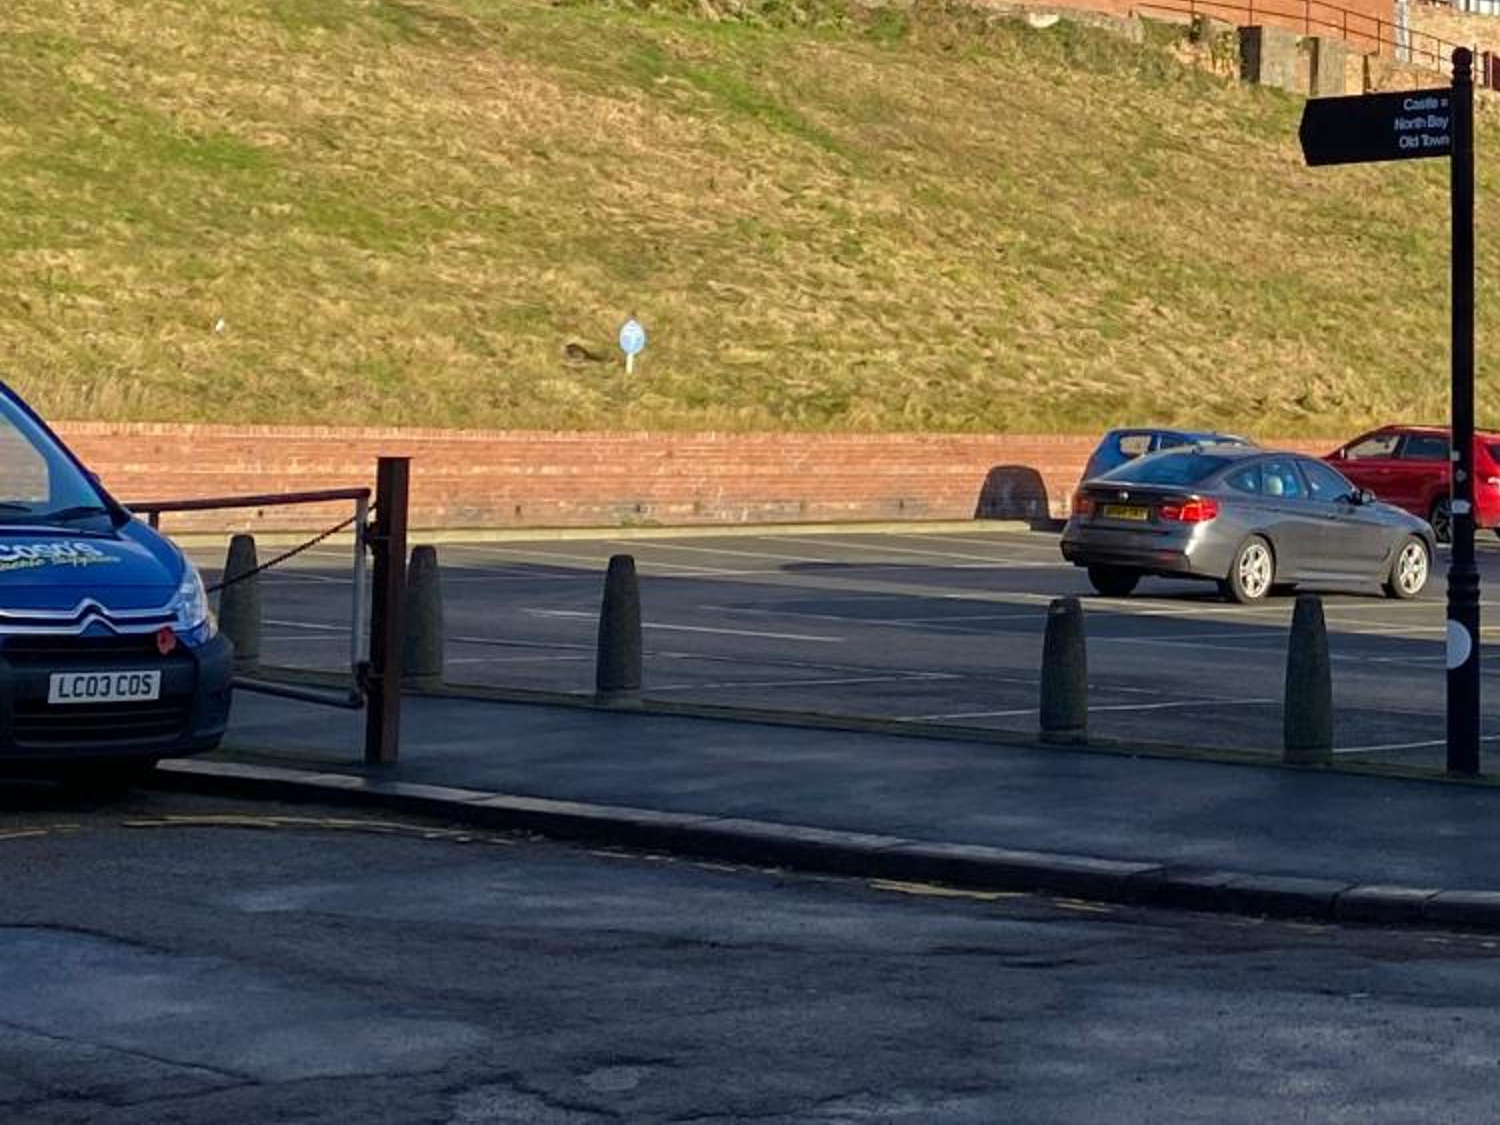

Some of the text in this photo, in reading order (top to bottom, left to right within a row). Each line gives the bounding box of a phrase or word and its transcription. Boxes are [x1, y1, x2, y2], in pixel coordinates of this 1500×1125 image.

[1403, 97, 1438, 111] Castle
[1394, 114, 1449, 130] North Bay
[1399, 133, 1450, 148] Old Town
[58, 674, 153, 698] LC03 COS
